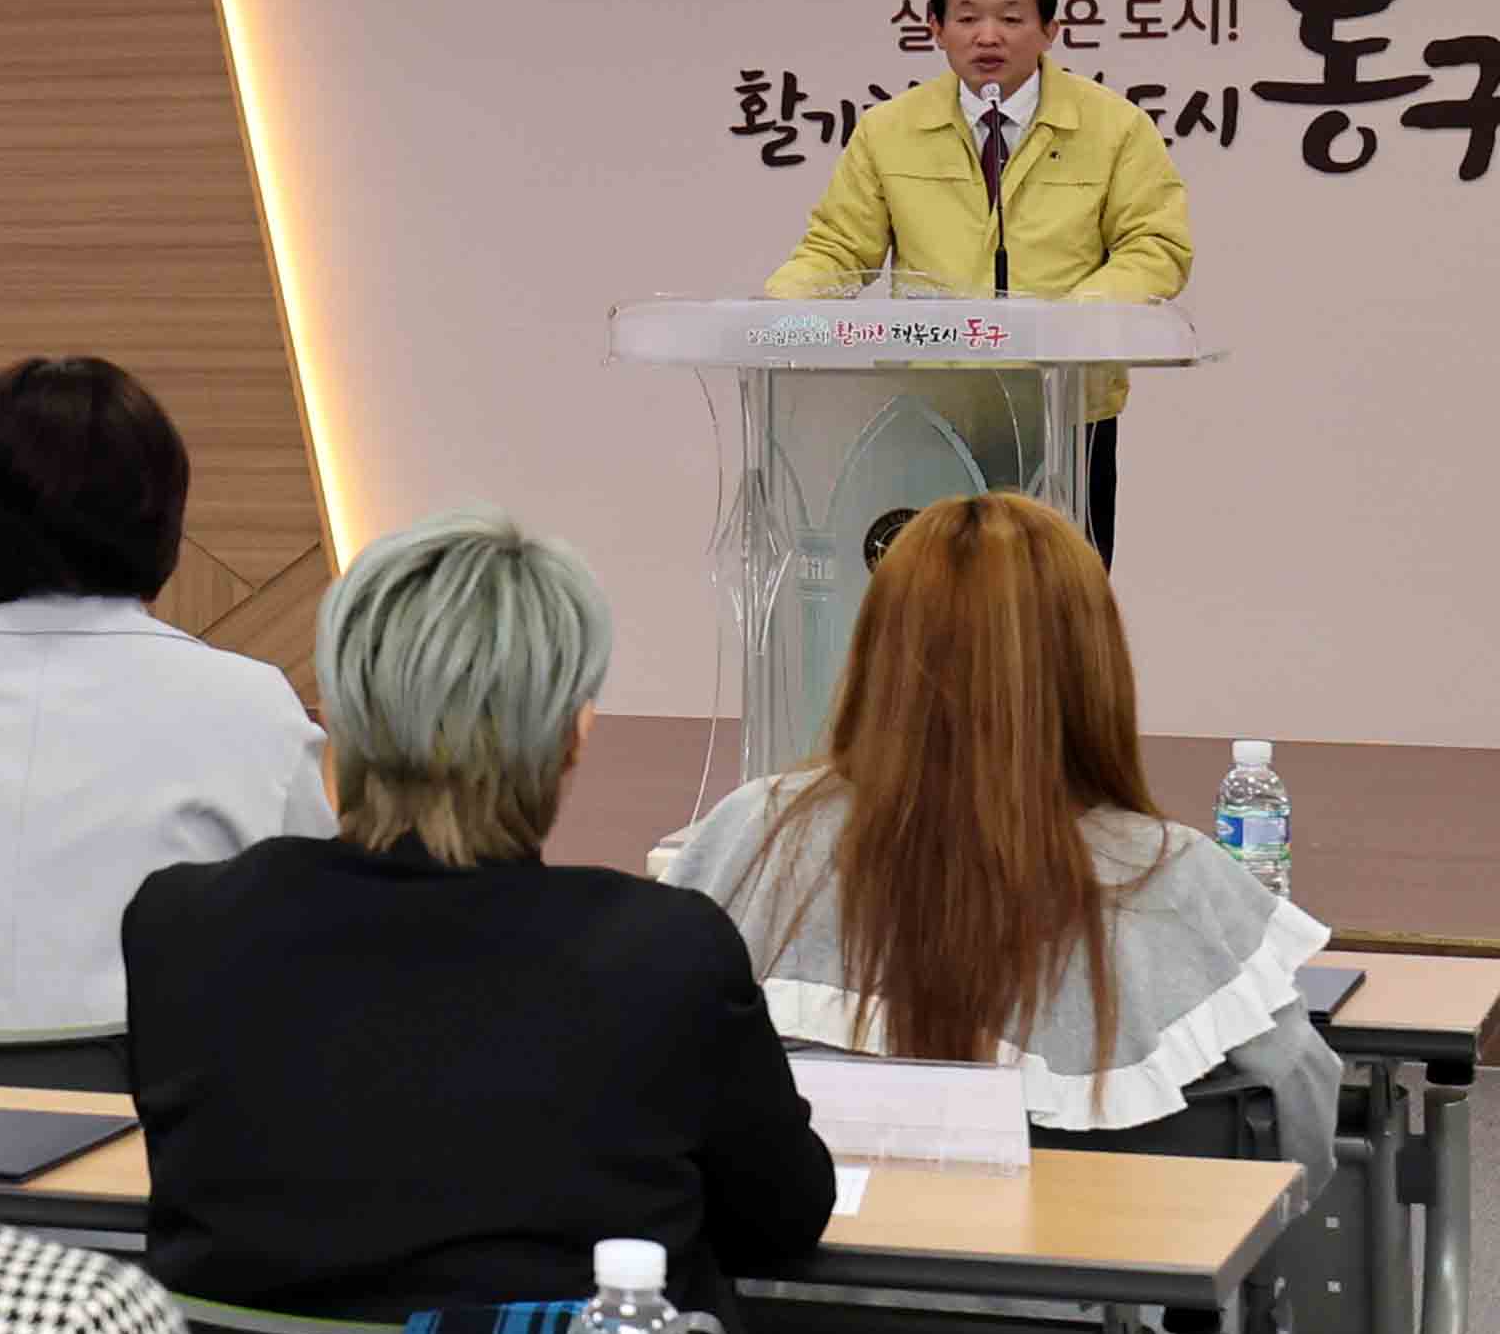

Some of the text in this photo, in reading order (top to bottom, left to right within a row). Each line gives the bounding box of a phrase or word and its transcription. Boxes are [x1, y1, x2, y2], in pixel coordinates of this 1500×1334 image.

[728, 69, 921, 168] 활기
[834, 320, 886, 346] 활기찬
[891, 322, 958, 346] 행복도시
[962, 318, 1010, 348] 동구
